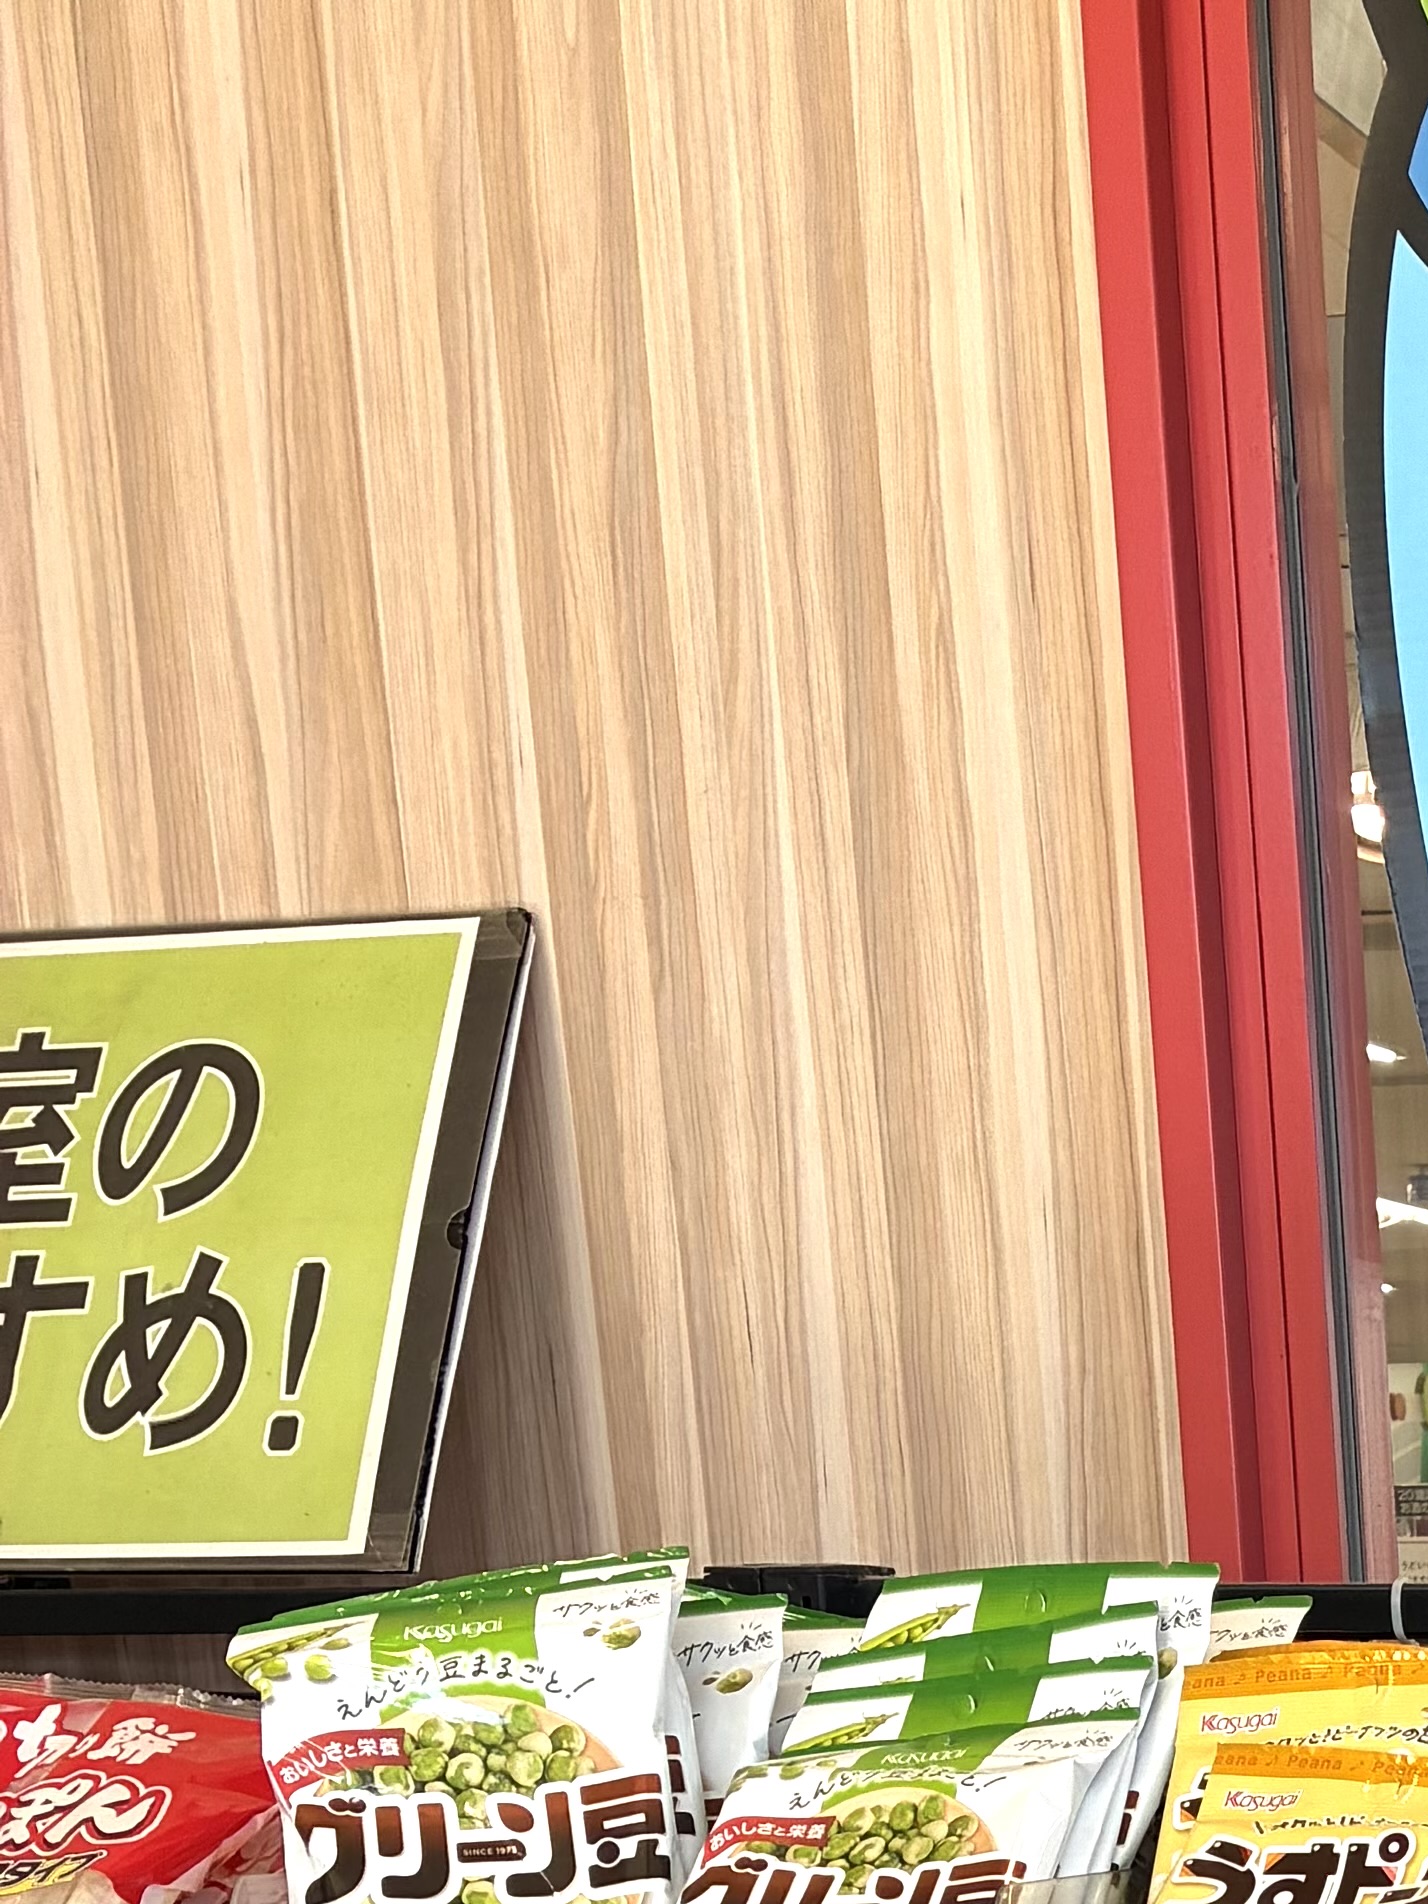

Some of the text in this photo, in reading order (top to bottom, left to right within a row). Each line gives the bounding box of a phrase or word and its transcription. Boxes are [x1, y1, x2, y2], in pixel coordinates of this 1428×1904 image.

[403, 1617, 503, 1641] Kasugai
[335, 1653, 596, 1722] えんどう豆まるごと!
[1202, 1705, 1281, 1735] Kasugai
[278, 1733, 403, 1784] おいしさと栄養
[1224, 1788, 1302, 1812] Kasugai
[707, 1821, 827, 1852] おいしさと栄養
